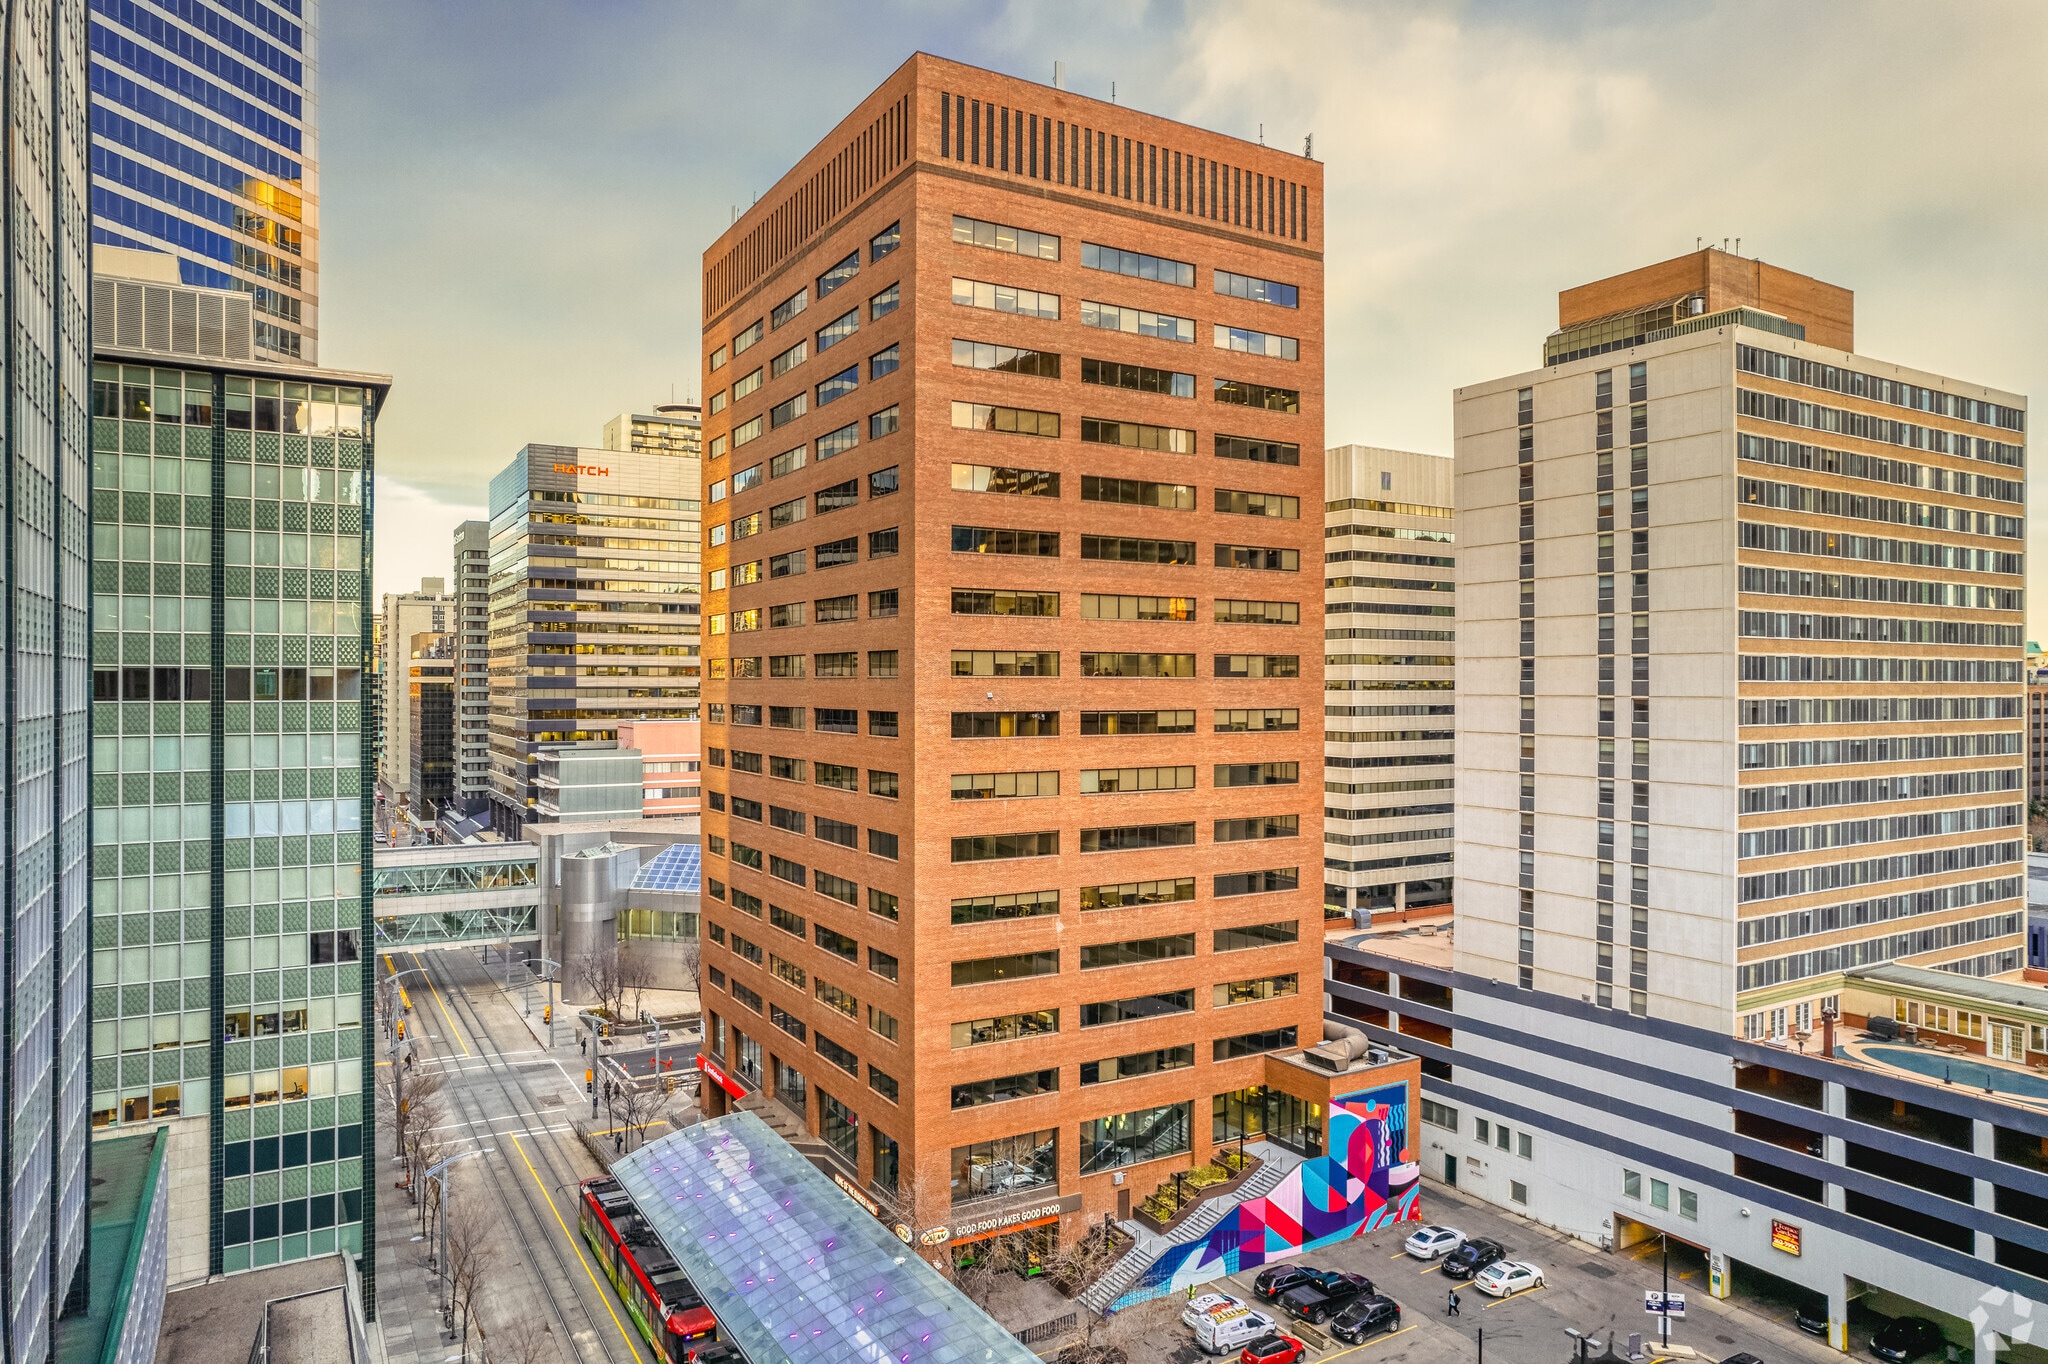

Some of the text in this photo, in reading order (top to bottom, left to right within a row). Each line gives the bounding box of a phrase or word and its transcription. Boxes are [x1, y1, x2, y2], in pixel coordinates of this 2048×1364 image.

[553, 462, 609, 477] HATCH
[956, 1204, 1060, 1236] GOOD FOOD MAKES GOOD FOOD
